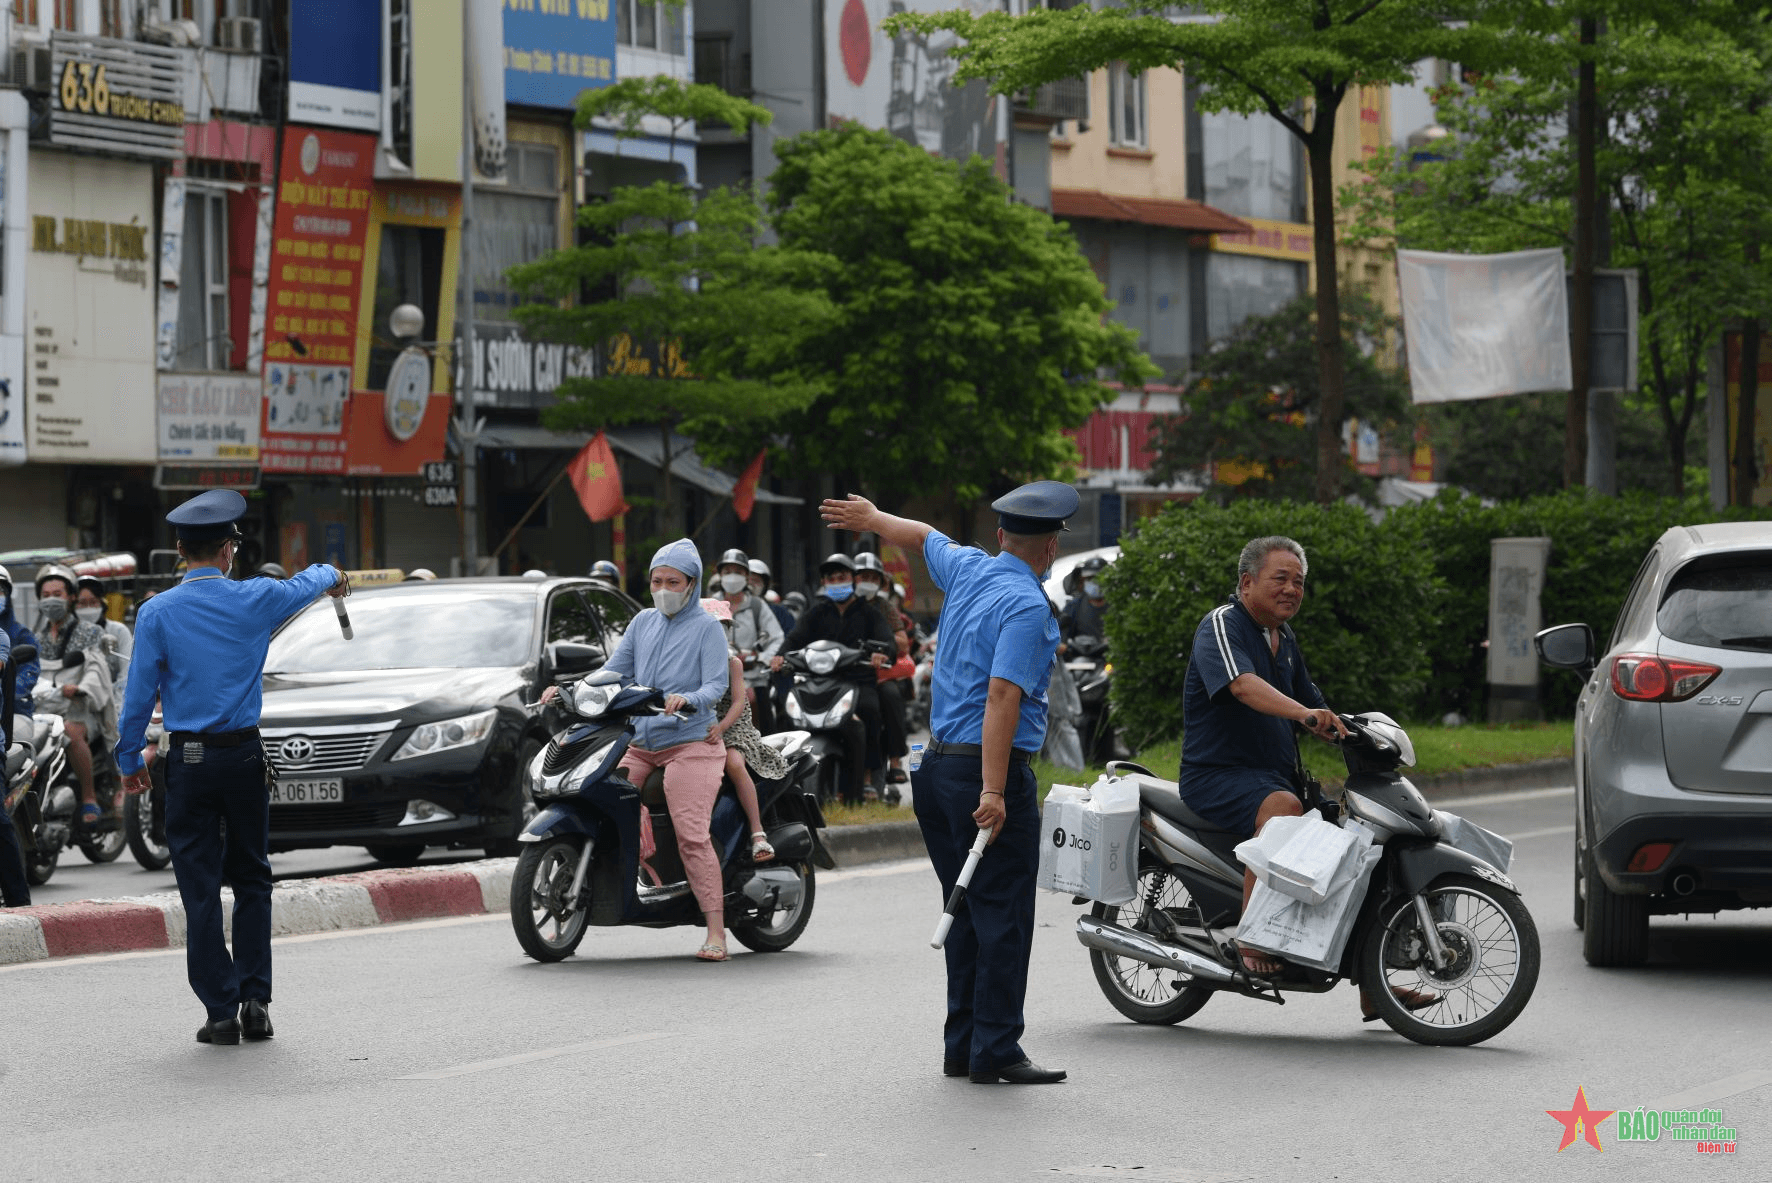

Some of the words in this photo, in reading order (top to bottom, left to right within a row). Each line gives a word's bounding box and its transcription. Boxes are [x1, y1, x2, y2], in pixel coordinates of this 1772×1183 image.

[61, 60, 110, 114] 636
[487, 330, 532, 391] SƯỜN
[535, 342, 564, 392] CAY
[427, 463, 454, 481] 636
[1696, 695, 1743, 705] CX-5
